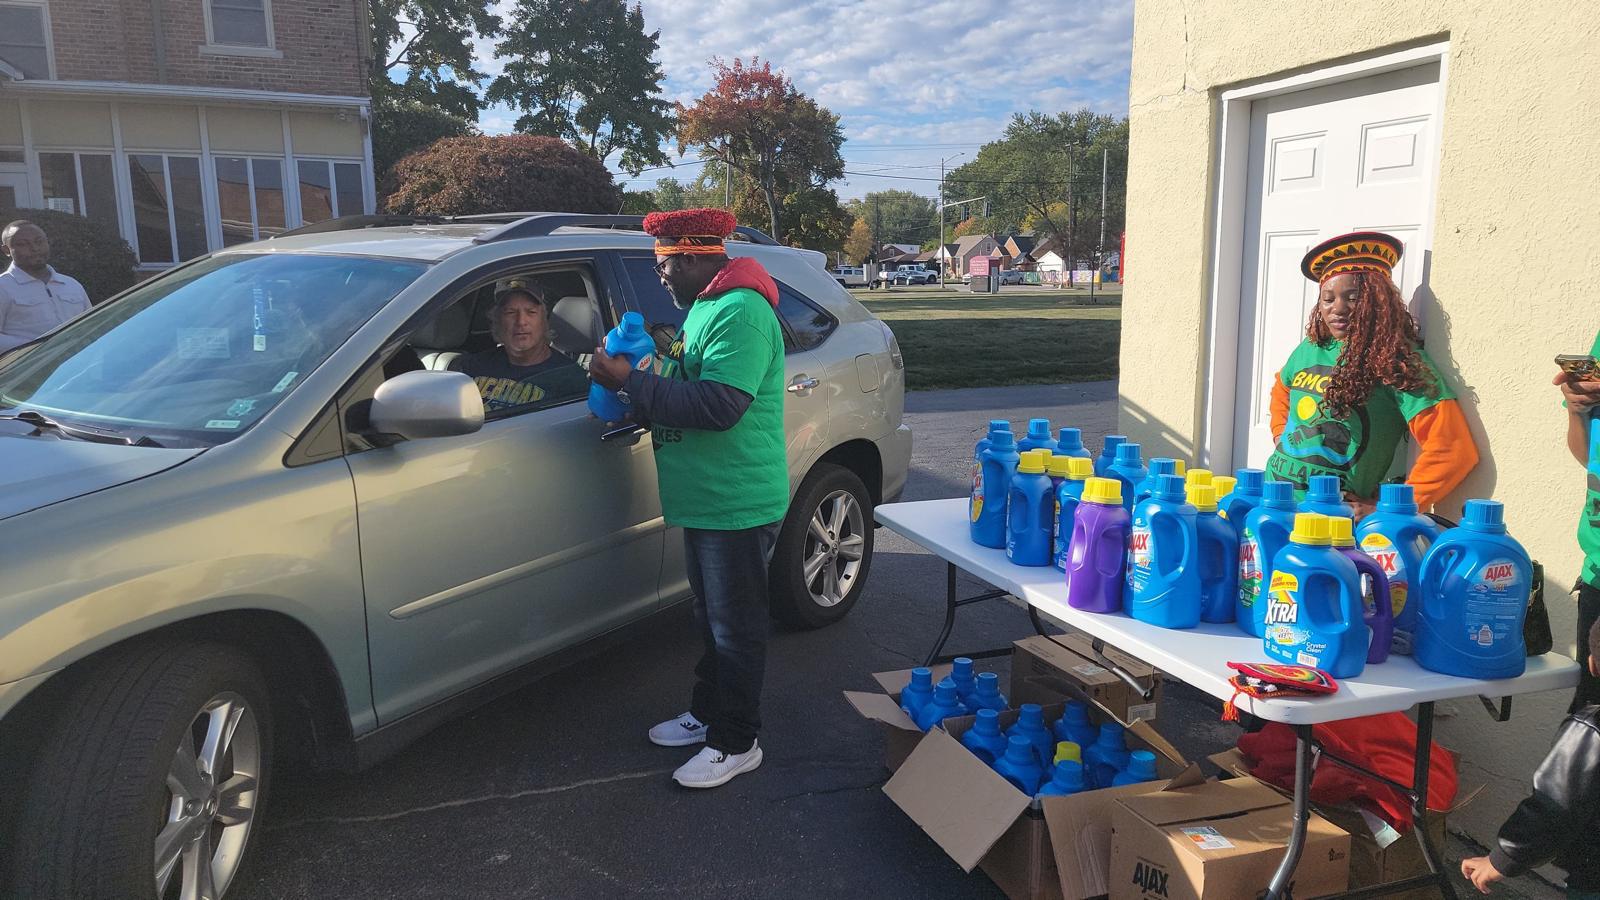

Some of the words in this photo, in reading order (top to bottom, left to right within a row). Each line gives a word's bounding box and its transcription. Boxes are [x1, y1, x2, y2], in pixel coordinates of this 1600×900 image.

[651, 426, 682, 443] AKES
[1485, 564, 1513, 582] AJAX
[1264, 598, 1298, 626] XTRA
[1132, 862, 1169, 898] AJAX
